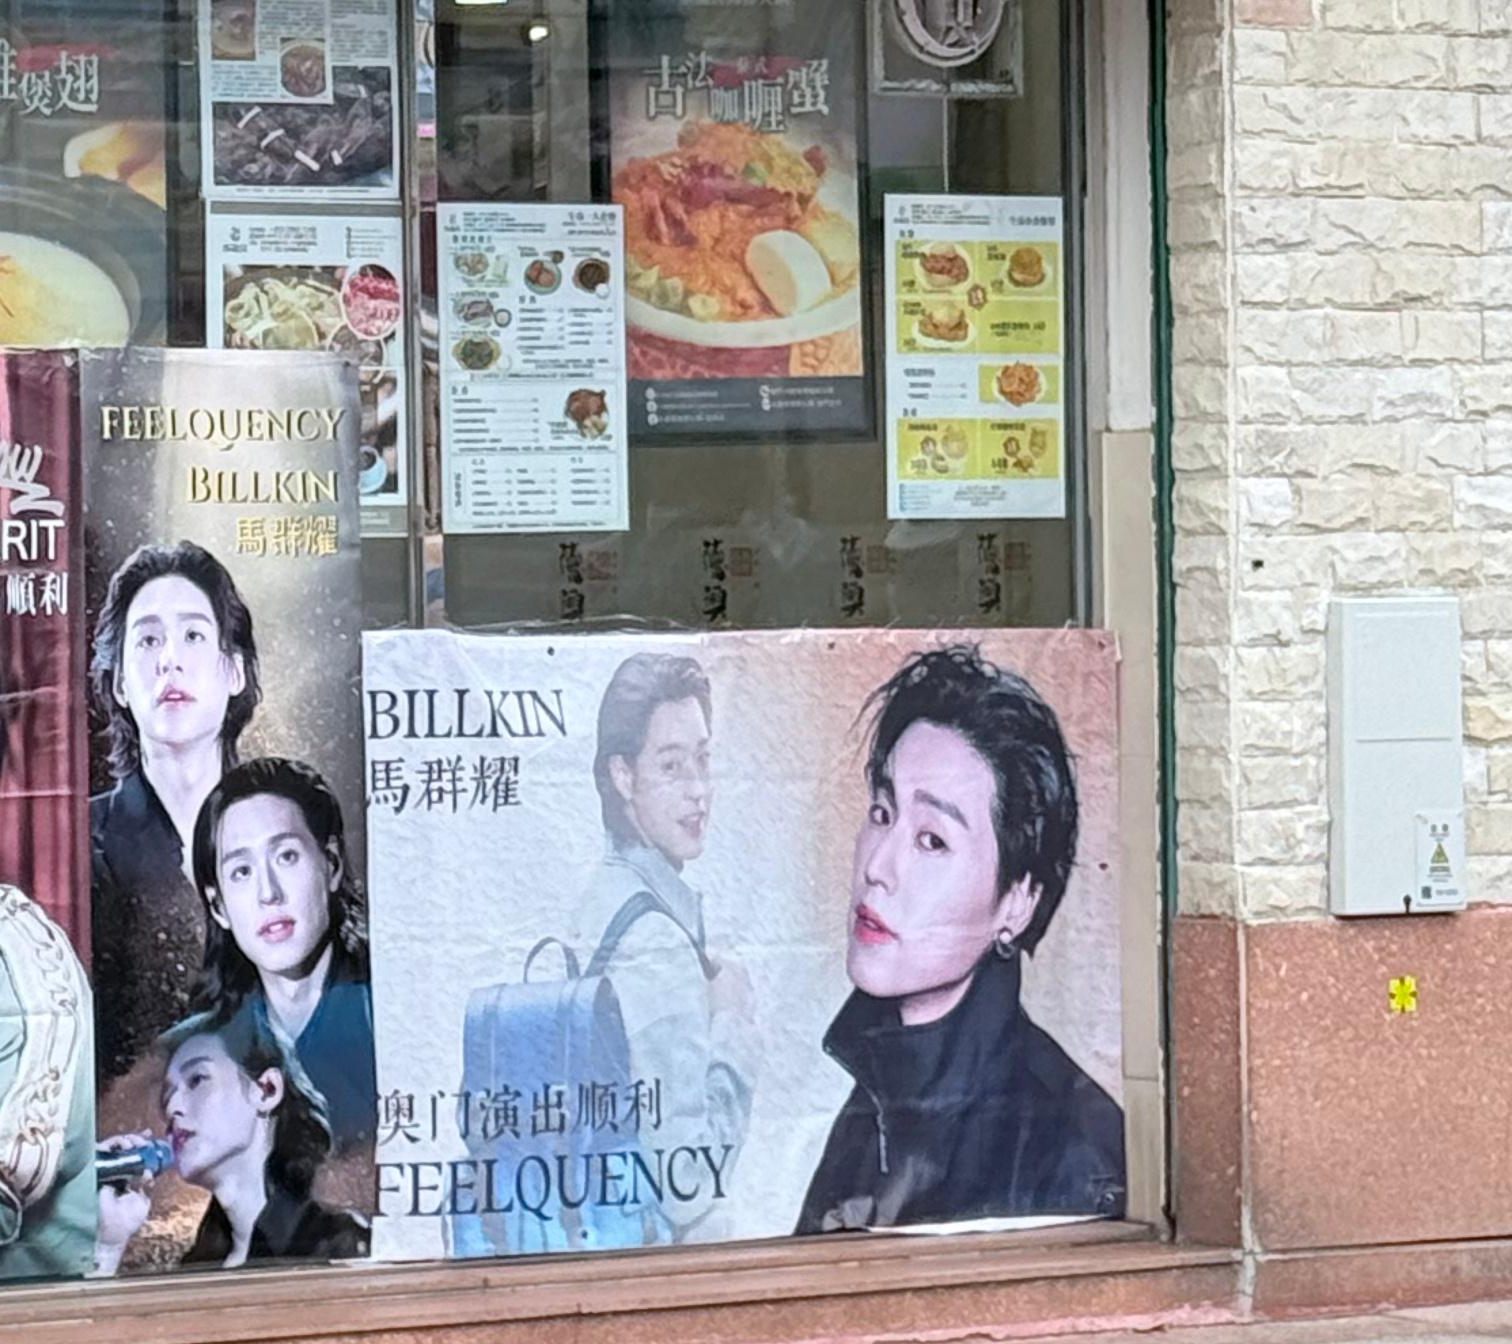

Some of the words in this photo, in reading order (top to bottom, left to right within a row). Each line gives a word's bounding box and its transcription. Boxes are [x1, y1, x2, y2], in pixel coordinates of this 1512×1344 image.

[100, 404, 348, 453] FEELQUENCY
[187, 463, 339, 505] BILLKIN
[366, 688, 568, 740] BILLKIN
[365, 753, 523, 816] 馬群耀
[376, 1077, 663, 1146] 澳门演出顺利
[375, 1143, 735, 1222] FEELQUENCY
